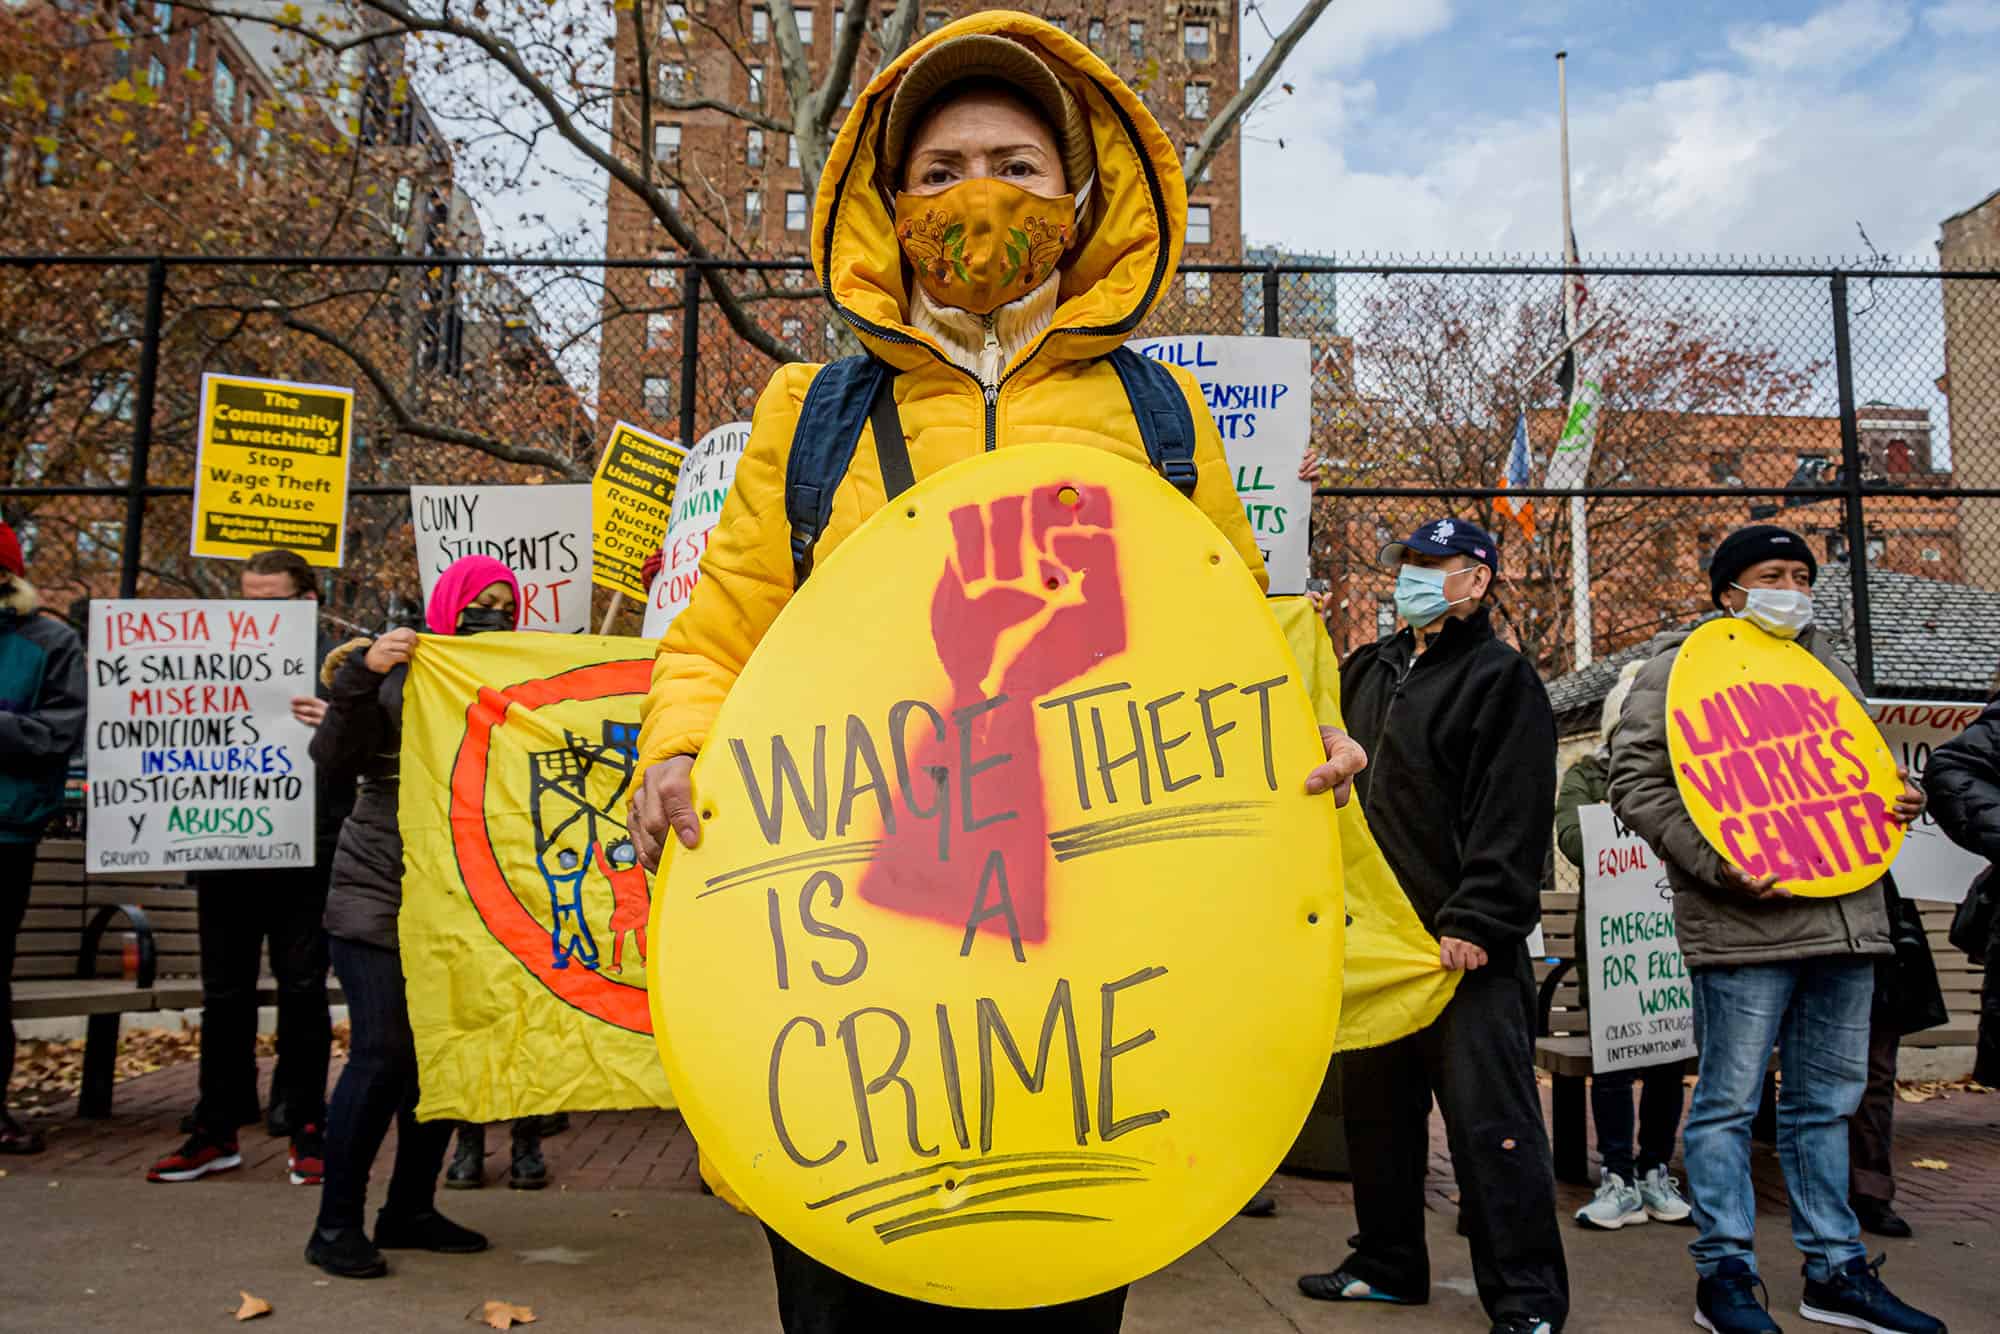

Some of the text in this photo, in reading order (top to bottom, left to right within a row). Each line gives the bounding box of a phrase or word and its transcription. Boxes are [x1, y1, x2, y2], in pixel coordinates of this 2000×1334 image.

[264, 392, 300, 409] The
[1200, 383, 1288, 410] ENSHIP
[214, 403, 339, 436] Community
[231, 428, 337, 454] watching!
[248, 451, 293, 471] Stop
[606, 463, 653, 492] Union
[210, 468, 331, 493] Wage Theft
[1236, 465, 1275, 493] LL
[228, 490, 315, 512] & Abuse
[419, 494, 480, 533] CUNY
[605, 520, 661, 550] Derech
[611, 507, 666, 538] Nuestr
[656, 569, 699, 610] CON
[96, 653, 305, 687] DE SALARIOS DE
[129, 685, 250, 716] MISERIA
[97, 716, 260, 750] CONDICIONES
[1673, 681, 1840, 756] LAUNDRY
[141, 745, 293, 775] INSALUBRES
[729, 675, 1288, 862] WAGE THEFT
[1679, 729, 1870, 813] WORKES
[93, 775, 302, 808] HOSTIGAMIENTO
[128, 805, 273, 844] Y ABUSOS
[1720, 792, 1902, 882] CENTER
[100, 842, 301, 867] GRUPO INTERNACIONALISTA
[1598, 845, 1648, 878] EQUAL
[766, 850, 1027, 990] IS A
[1600, 911, 1676, 948] EMERGEN
[1603, 950, 1692, 991] FOR EXCL
[1638, 986, 1694, 1016] WORK
[1605, 1022, 1643, 1041] CLASS
[768, 965, 1170, 1168] CRIME
